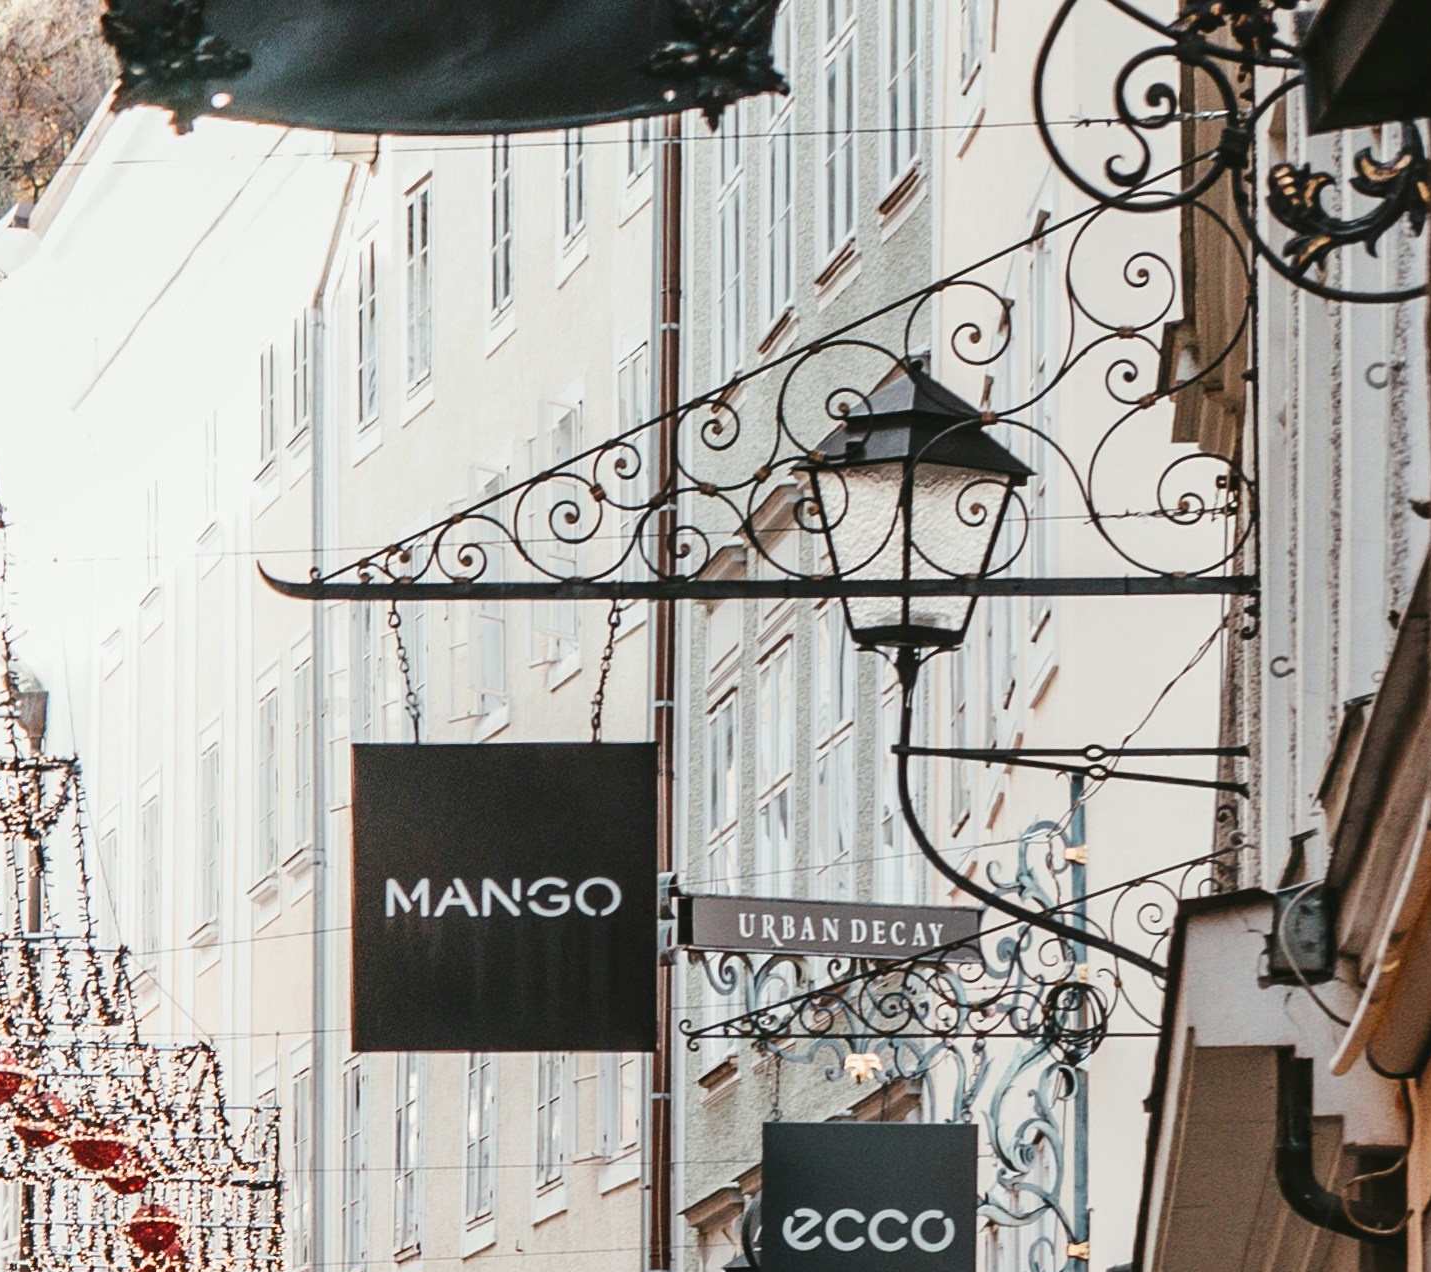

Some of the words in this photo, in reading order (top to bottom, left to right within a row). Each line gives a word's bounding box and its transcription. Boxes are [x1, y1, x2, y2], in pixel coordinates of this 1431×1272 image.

[385, 876, 622, 918] MANGO
[739, 912, 840, 948] URBAN
[849, 917, 945, 948] DECAY
[782, 1207, 955, 1253] ecco
